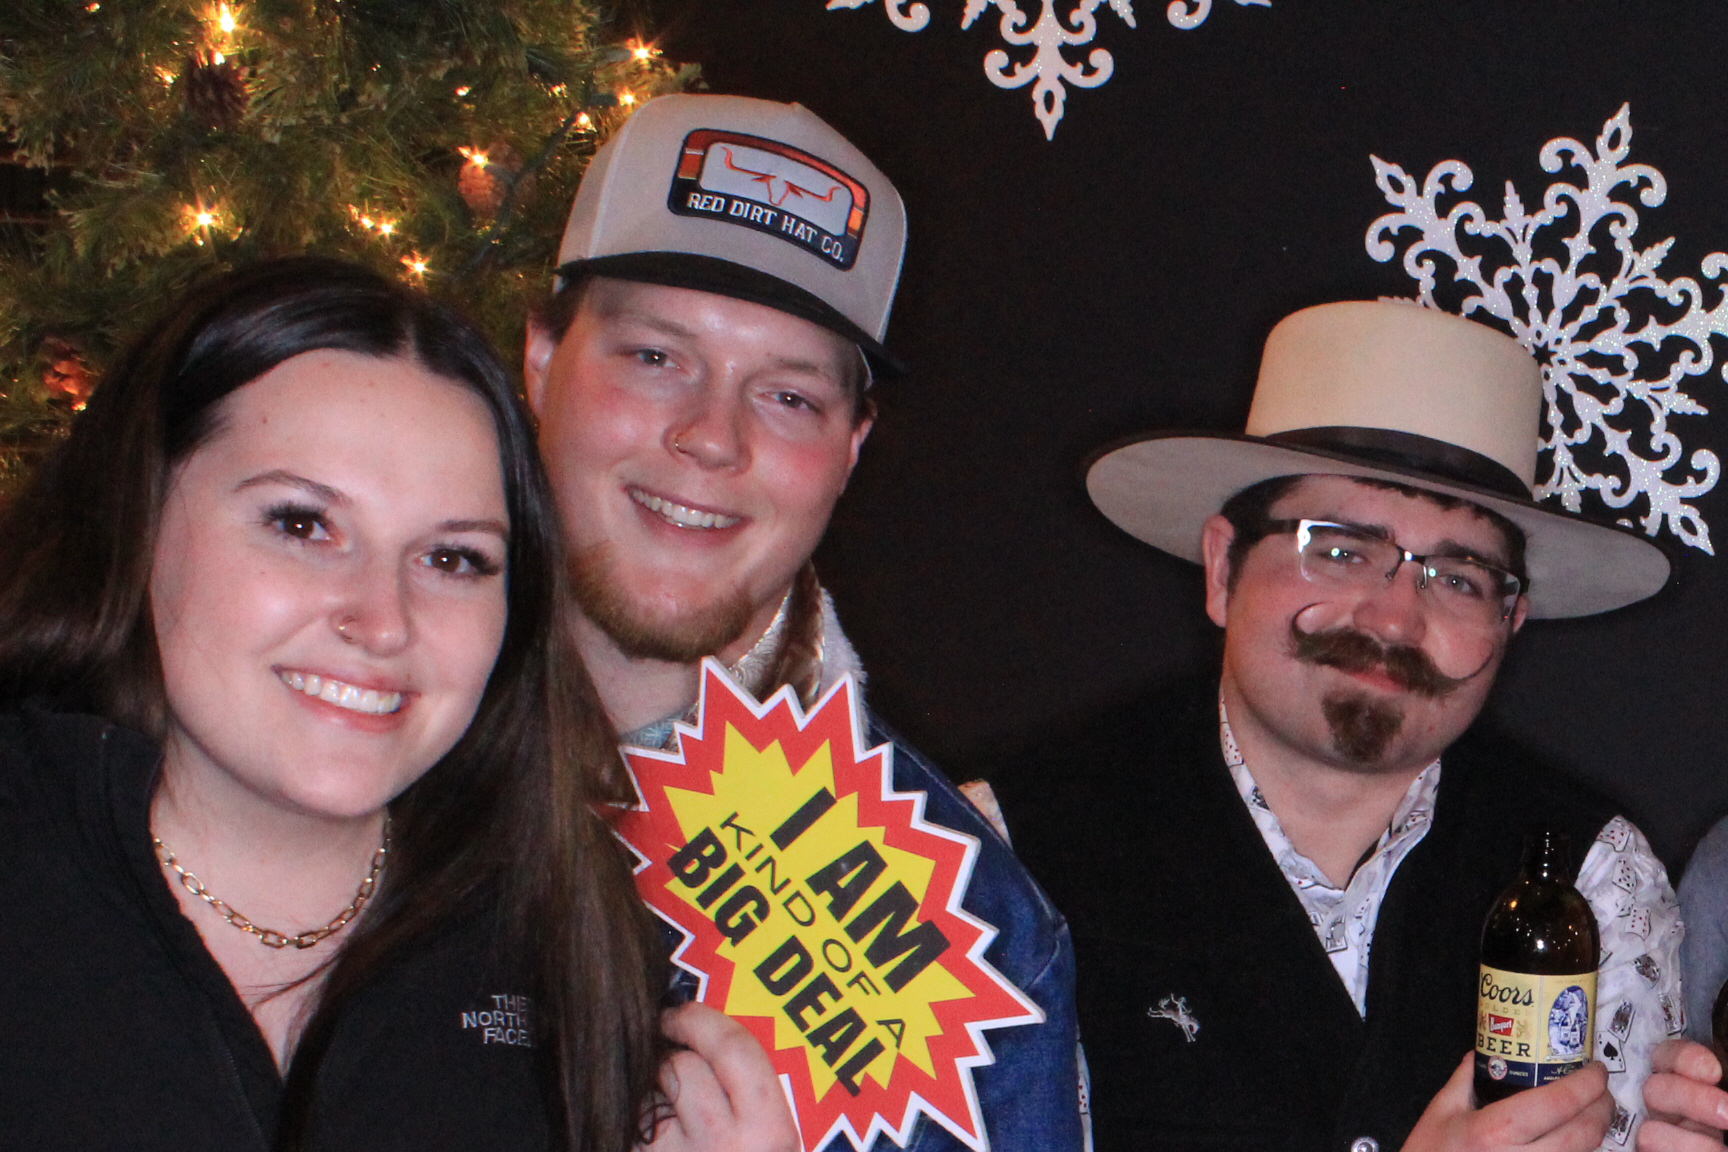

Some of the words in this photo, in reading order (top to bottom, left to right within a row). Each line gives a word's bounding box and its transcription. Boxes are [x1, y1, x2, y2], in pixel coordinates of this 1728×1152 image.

[686, 192, 725, 214] RED
[729, 200, 777, 226] DIRT
[781, 215, 819, 244] HAT
[821, 236, 845, 263] CO.
[769, 786, 837, 851] I
[805, 839, 951, 994] AM
[719, 810, 817, 928] KIND
[822, 938, 881, 998] OF
[875, 1017, 907, 1050] A
[666, 826, 771, 948] BIG
[753, 935, 887, 1099] DEAL
[491, 993, 528, 1012] THE
[1480, 973, 1535, 1007] Coors
[461, 1009, 528, 1029] NORTH
[483, 1027, 531, 1047] FACE
[1478, 1032, 1531, 1057] BEER
